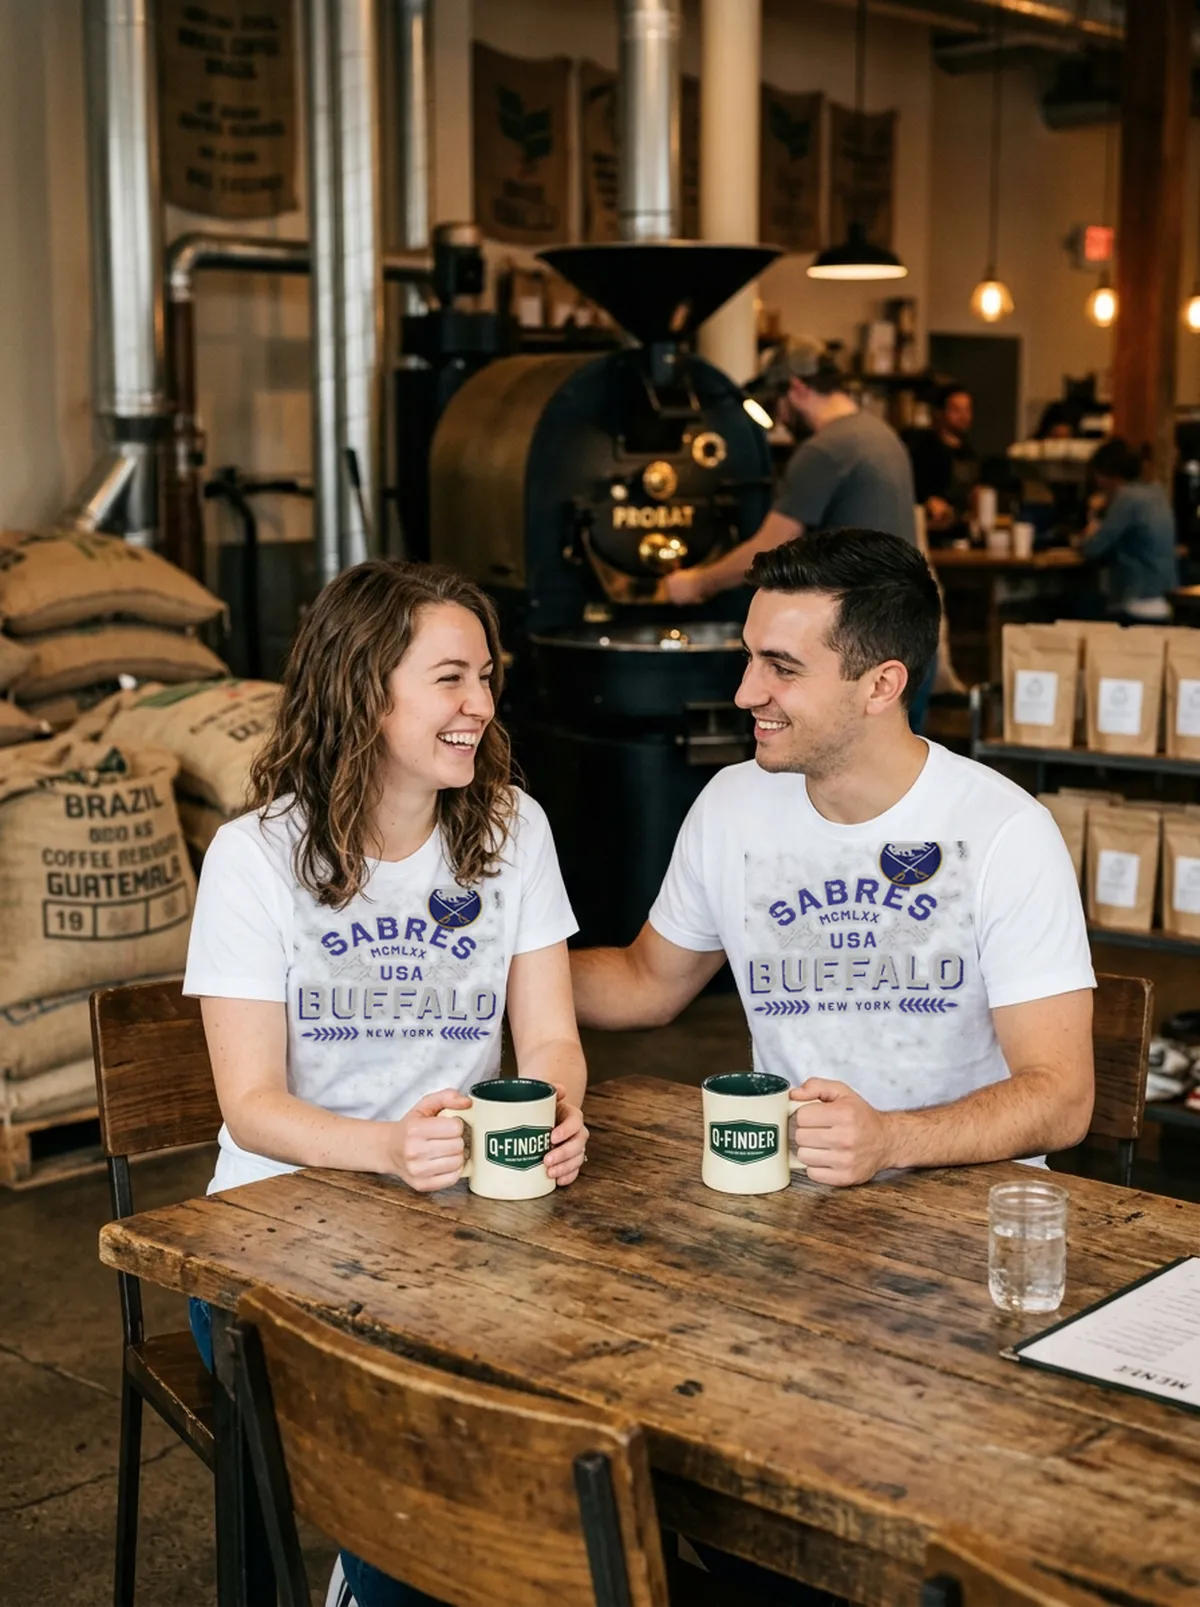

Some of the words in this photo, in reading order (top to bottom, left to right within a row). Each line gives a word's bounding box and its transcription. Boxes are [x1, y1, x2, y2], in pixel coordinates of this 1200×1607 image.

[65, 786, 164, 819] BRAZIL
[42, 848, 112, 868] COFFEE
[46, 855, 181, 897] GUATEMALA
[768, 878, 938, 926] SABRES
[56, 911, 84, 932] 19
[819, 910, 880, 926] MCMLXX
[320, 916, 477, 960] SABRES
[829, 931, 877, 949] USA
[371, 946, 427, 959] MCMLXX
[380, 965, 423, 981] USA
[749, 954, 965, 994] BUFFALO
[298, 986, 497, 1021] BUFFALO
[817, 1001, 848, 1012] NEW
[855, 1001, 892, 1012] YORK
[366, 1028, 395, 1038] NEW
[402, 1028, 434, 1038] YORK
